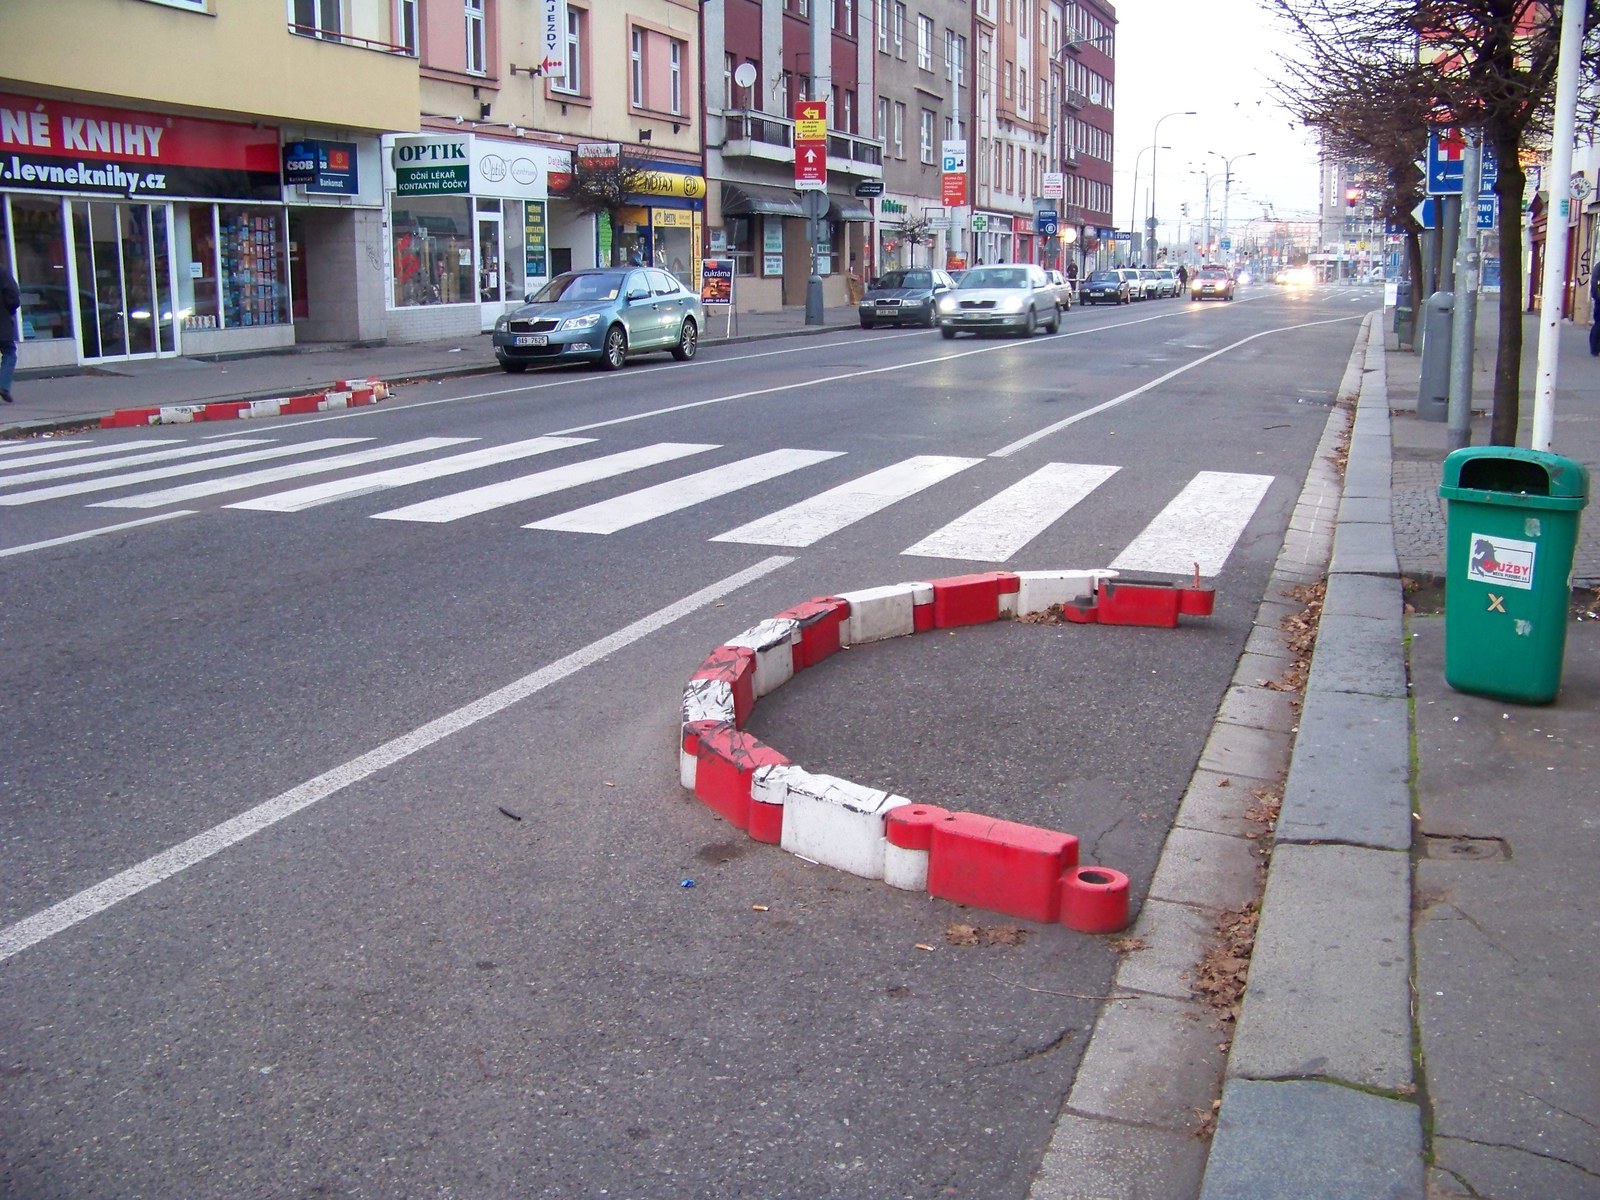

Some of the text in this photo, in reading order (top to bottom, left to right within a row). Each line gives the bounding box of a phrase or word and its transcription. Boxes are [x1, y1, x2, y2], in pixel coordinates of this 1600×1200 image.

[62, 116, 164, 158] KNIHY
[398, 143, 466, 161] OPTIK
[0, 156, 166, 193] .levneknihy.cz
[410, 170, 455, 180] OČNÍ LÉKAŘ
[320, 178, 344, 188] Bankomat
[399, 179, 468, 191] KONTAKTNÍ ČOČKY
[663, 210, 676, 225] berry
